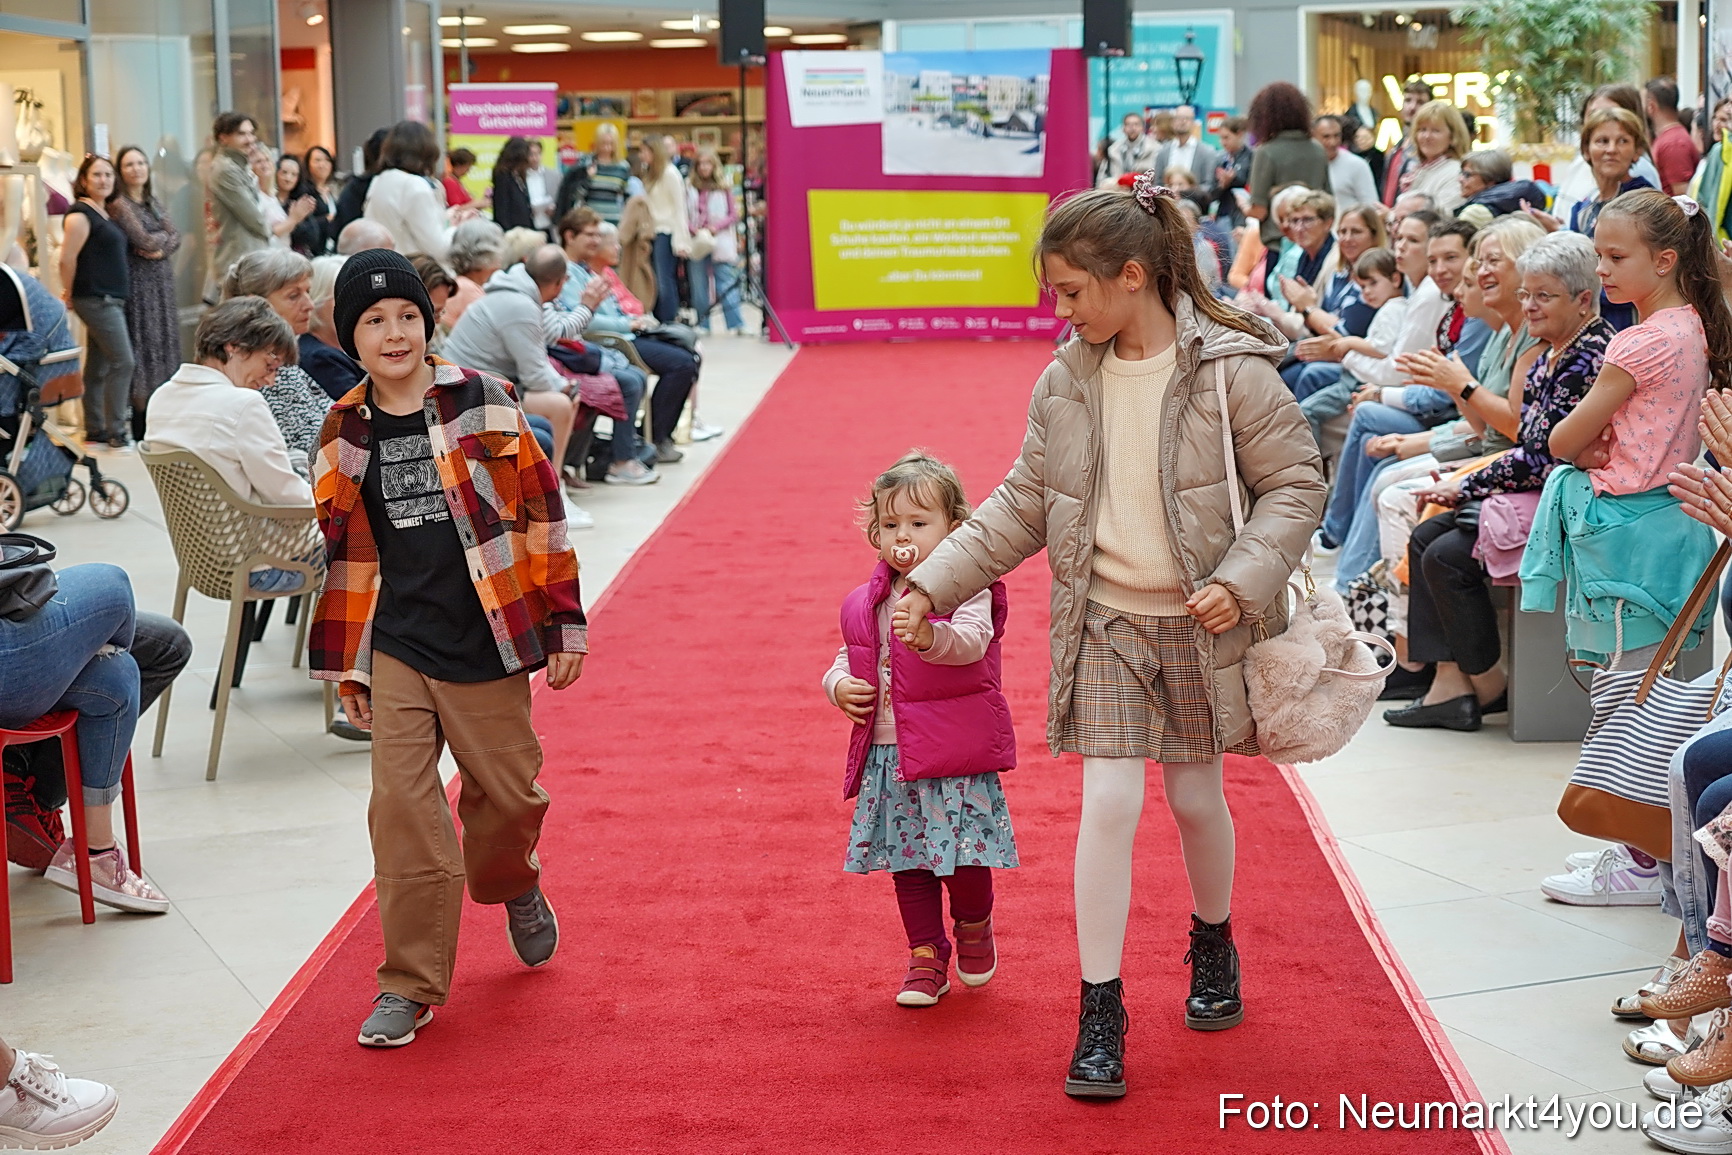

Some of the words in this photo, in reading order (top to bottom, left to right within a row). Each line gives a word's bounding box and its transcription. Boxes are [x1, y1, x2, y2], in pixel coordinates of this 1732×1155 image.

[1382, 70, 1523, 109] VER
[455, 102, 525, 116] Verschenken
[528, 101, 547, 114] Sie
